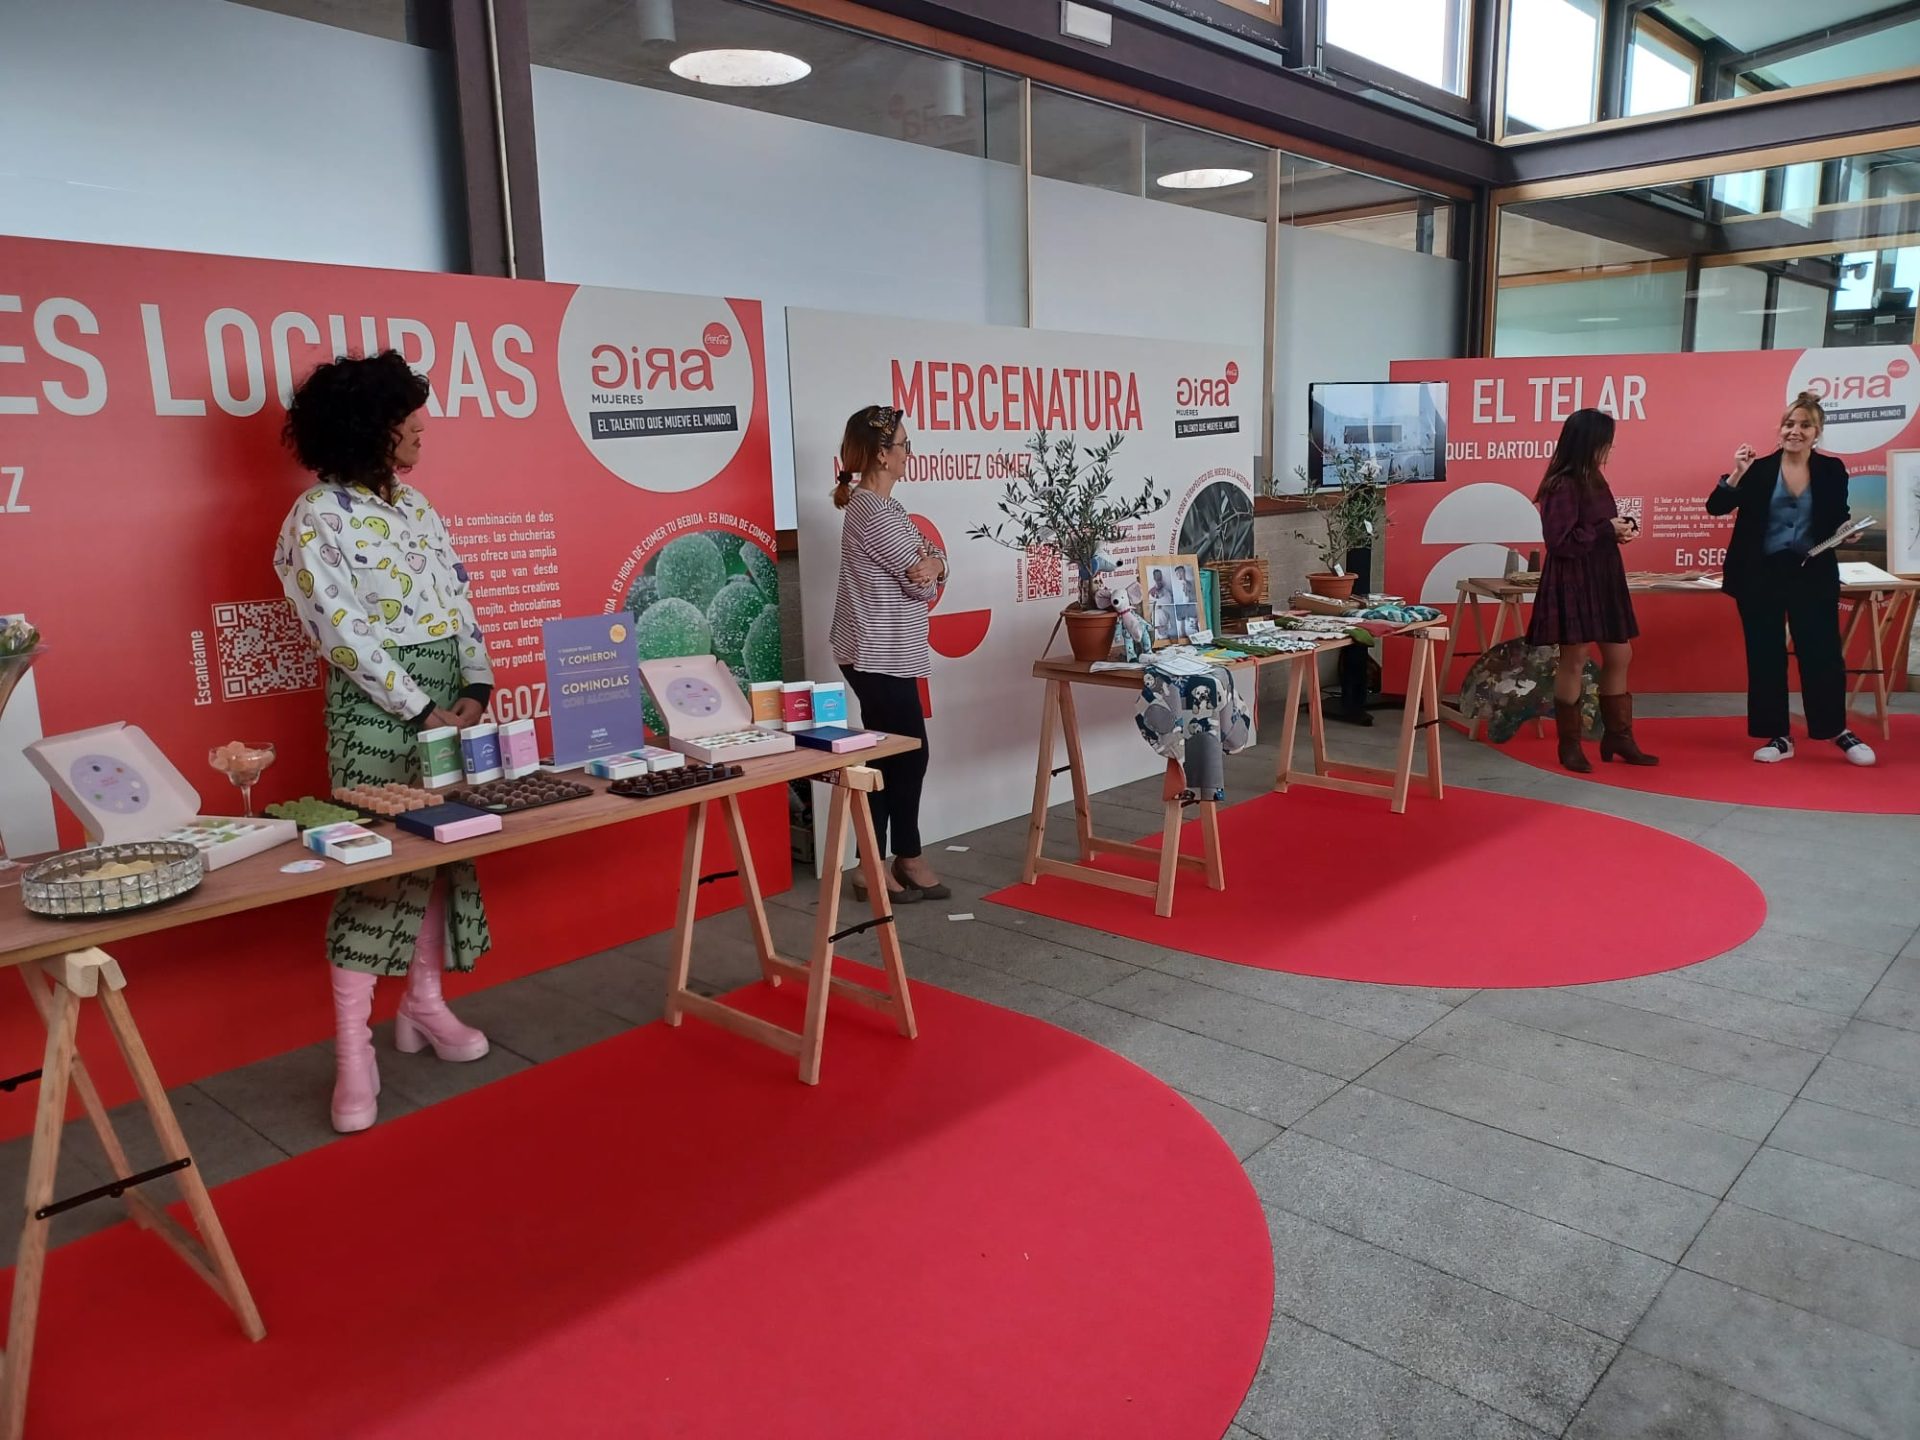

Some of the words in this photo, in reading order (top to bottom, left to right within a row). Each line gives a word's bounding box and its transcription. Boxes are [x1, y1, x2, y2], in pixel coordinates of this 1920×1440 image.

[591, 394, 644, 405] MUJERES
[891, 359, 1143, 431] MERCENATURA
[1473, 378, 1515, 423] EL
[598, 419, 609, 432] EL
[610, 417, 645, 431] TALENTO
[646, 416, 663, 429] QUE
[665, 415, 692, 428] MUEVE
[693, 414, 703, 426] EL
[704, 413, 731, 425] MUNDO
[986, 447, 1032, 480] GÓMEZ
[455, 515, 463, 527] la
[467, 513, 522, 526] combinación
[525, 512, 536, 523] de
[539, 511, 554, 522] dos
[450, 532, 492, 547] dispares:
[493, 531, 508, 543] las
[510, 529, 556, 542] chucherías
[481, 550, 508, 562] ofrece
[511, 550, 527, 560] una
[529, 546, 557, 561] amplia
[611, 579, 624, 592] ES
[618, 557, 637, 581] HORA
[633, 545, 646, 560] DE
[643, 526, 668, 551] COMER
[665, 520, 678, 534] TU
[676, 512, 703, 529] BEBIDA
[708, 512, 718, 524] ES
[719, 512, 738, 527] HORA
[739, 519, 749, 531] DE
[748, 523, 772, 546] COMER
[1675, 548, 1693, 566] En
[491, 568, 506, 582] que
[512, 566, 528, 577] van
[534, 563, 558, 575] desde
[476, 584, 520, 598] elementos
[522, 581, 560, 594] creativos
[510, 598, 561, 613] chocolatinas
[503, 619, 519, 630] con
[521, 616, 543, 629] leche
[517, 635, 539, 647] entre
[491, 656, 510, 669] very
[512, 652, 533, 668] good
[560, 657, 566, 666] Y
[568, 650, 617, 665] COMIERON
[189, 630, 212, 706] Escanéame
[561, 674, 630, 695] GOMINOLAS
[479, 683, 551, 724] AGOZ
[342, 731, 396, 764] forever
